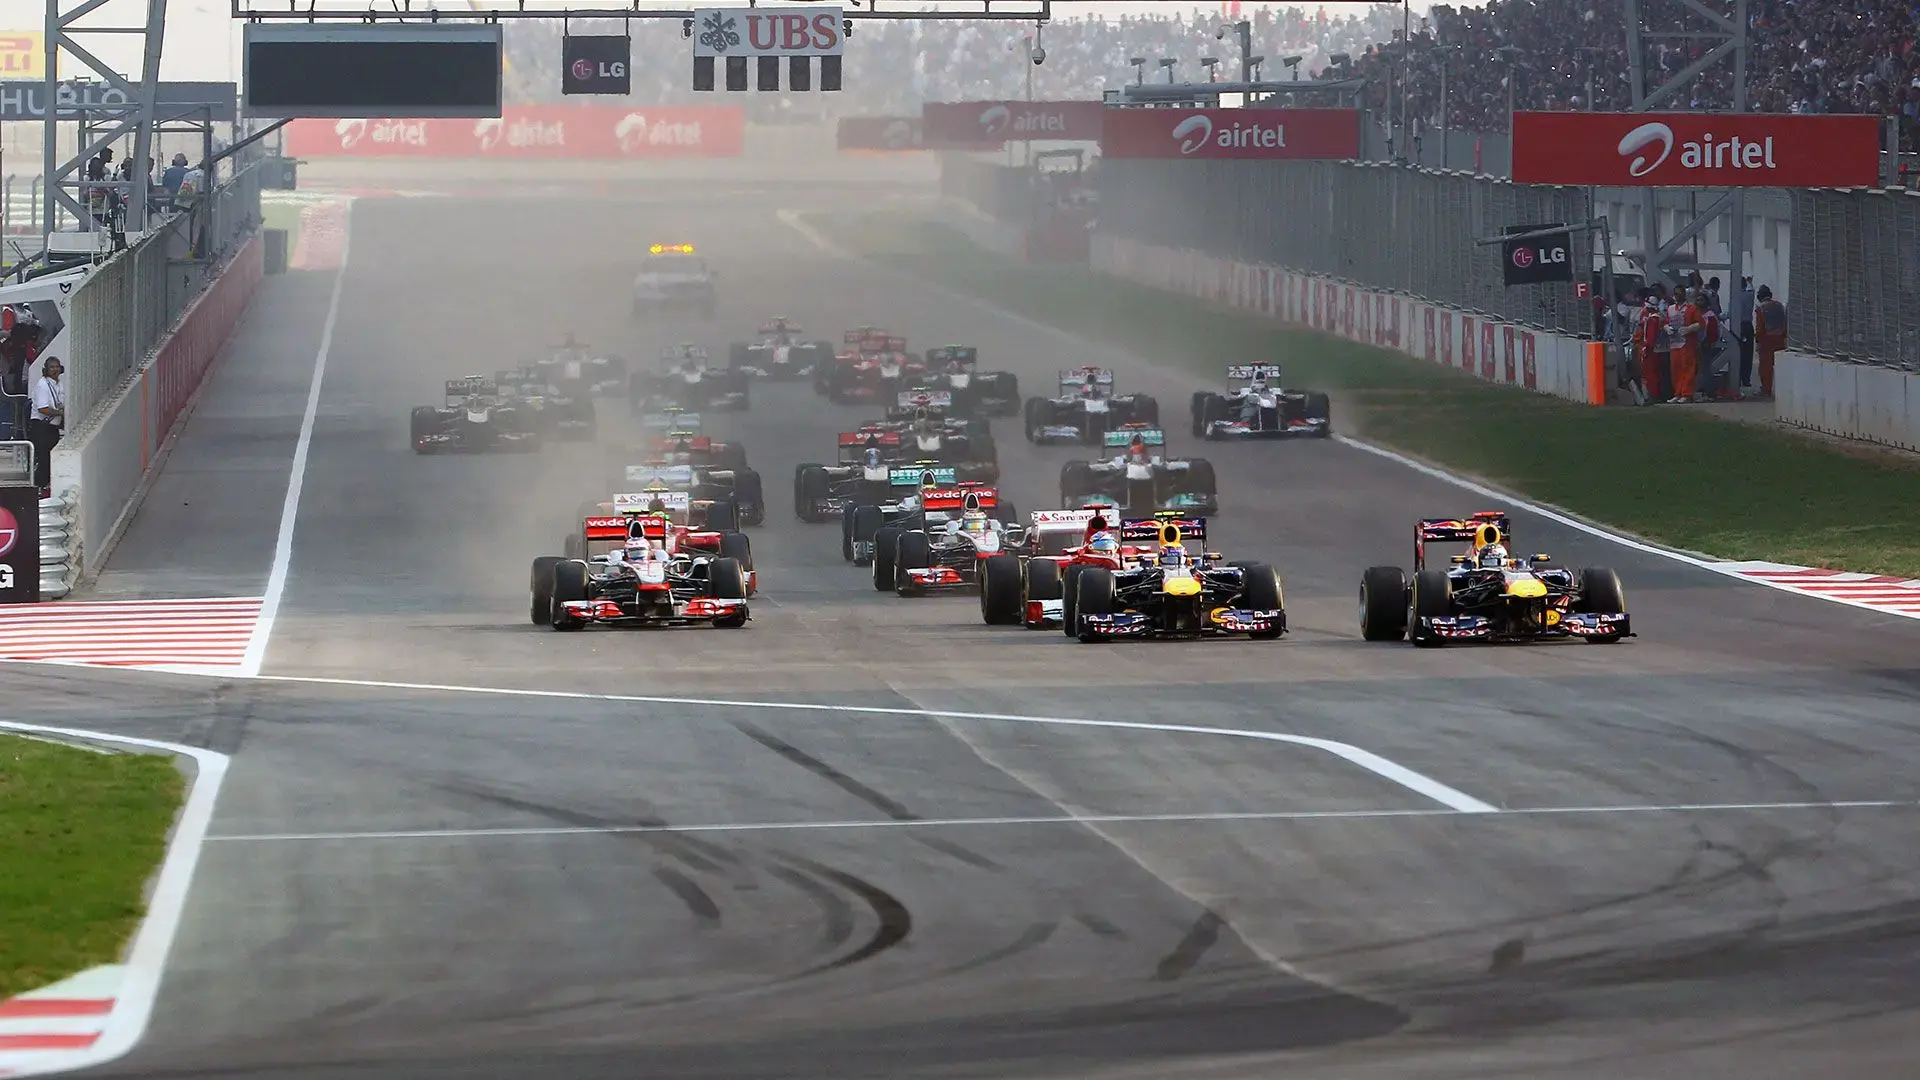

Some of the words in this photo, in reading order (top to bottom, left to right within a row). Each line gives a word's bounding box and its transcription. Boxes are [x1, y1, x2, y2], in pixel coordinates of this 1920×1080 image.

[746, 14, 838, 50] UBS
[599, 62, 625, 77] LG
[0, 87, 129, 115] HUBLO
[1013, 111, 1066, 132] airtel
[1217, 122, 1286, 148] airtel
[1680, 132, 1777, 169] airtel
[1539, 247, 1566, 264] LG
[1577, 283, 1586, 298] F
[889, 467, 955, 477] PETRNAS
[924, 489, 993, 500] vodafne
[587, 517, 661, 527] vodafne
